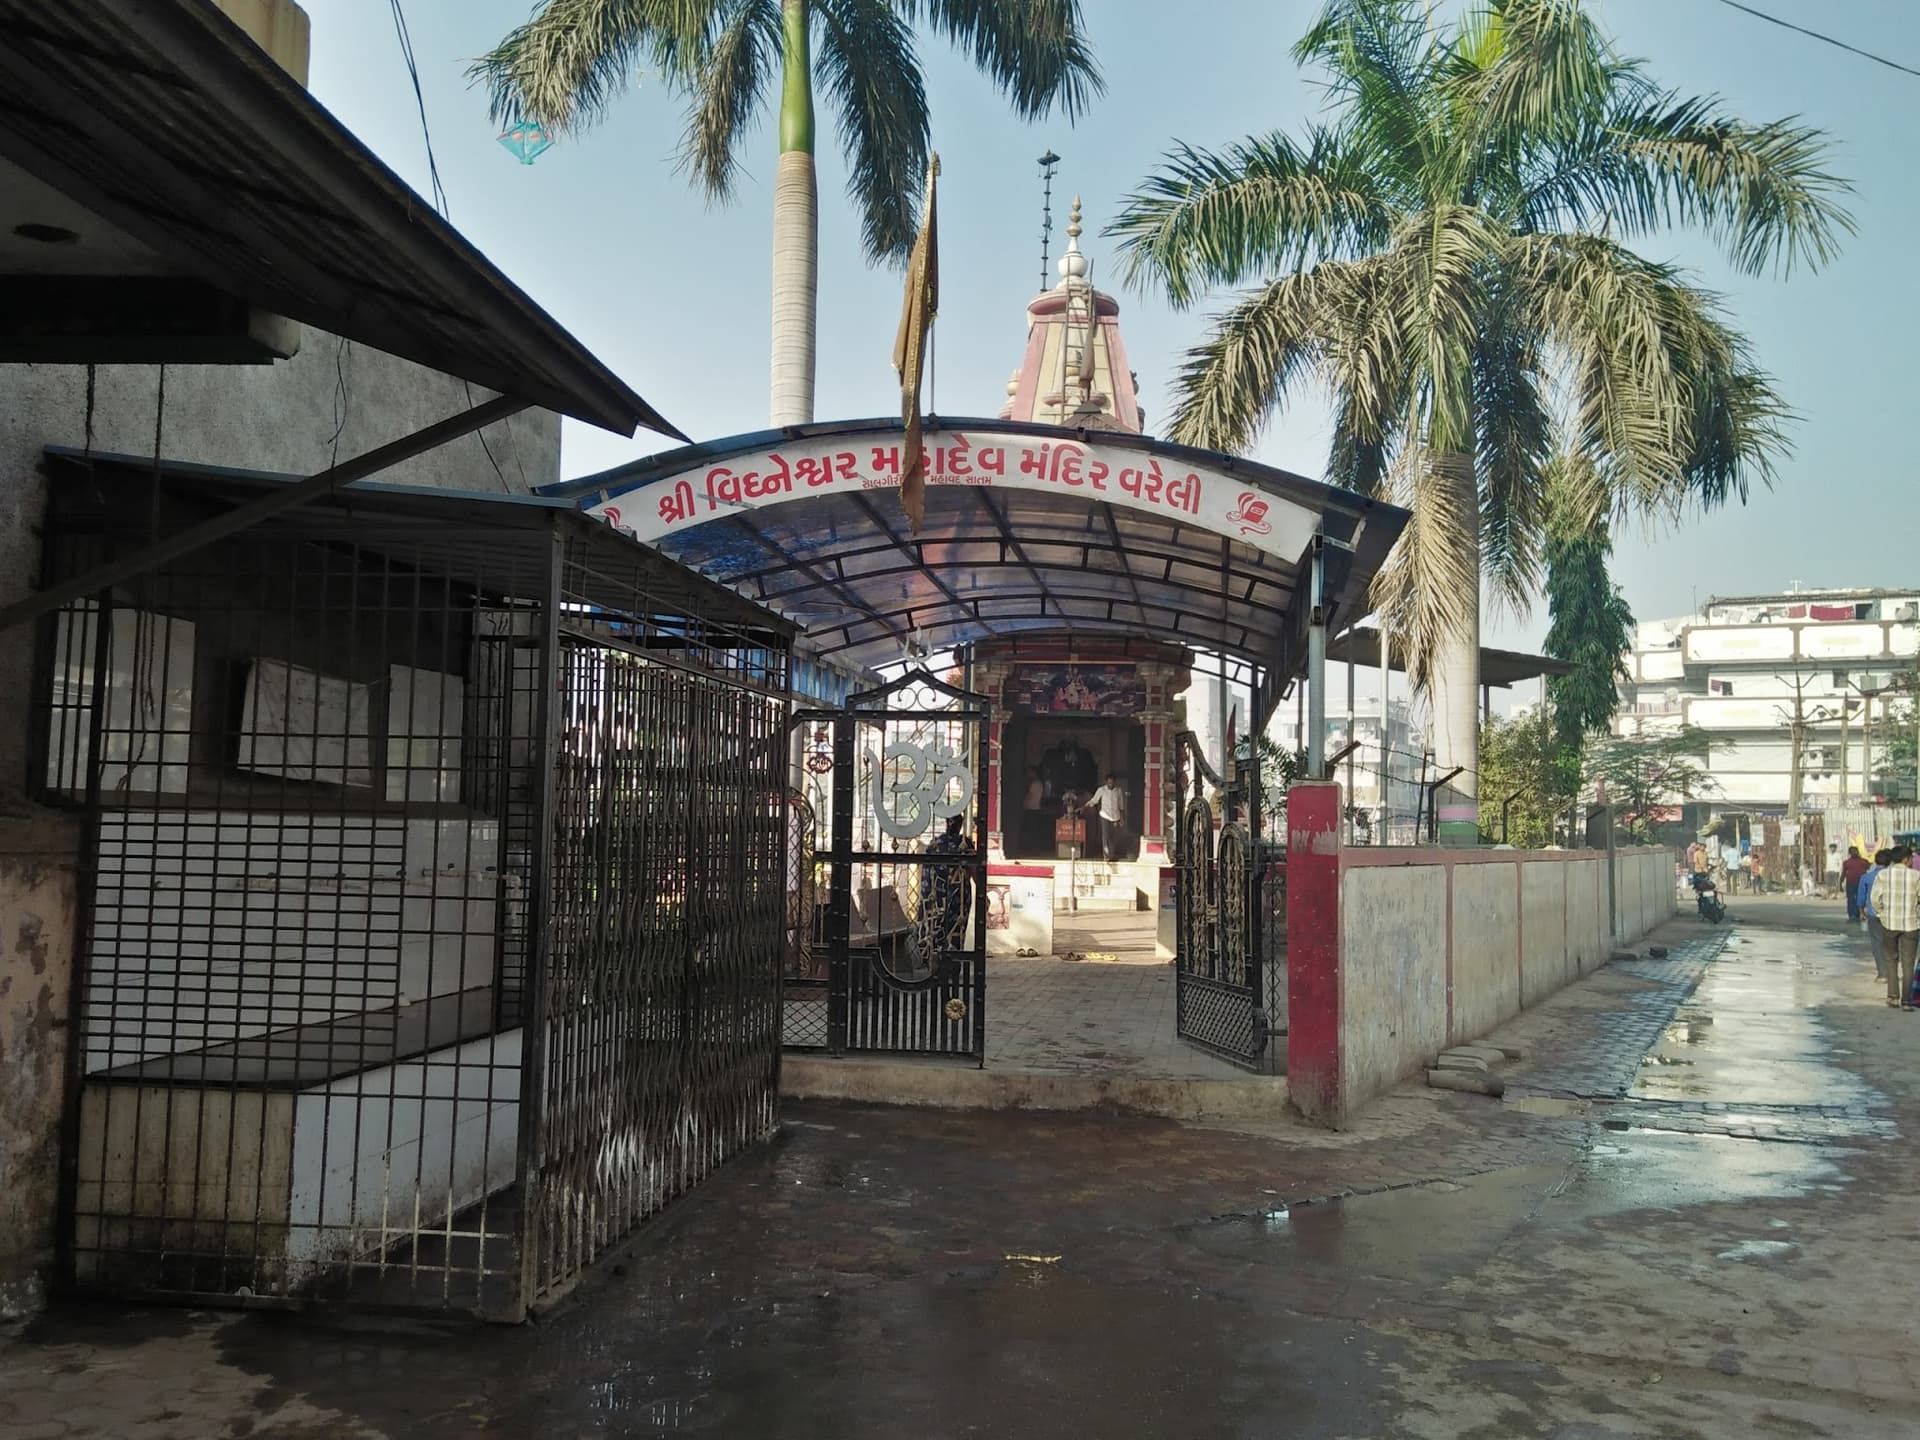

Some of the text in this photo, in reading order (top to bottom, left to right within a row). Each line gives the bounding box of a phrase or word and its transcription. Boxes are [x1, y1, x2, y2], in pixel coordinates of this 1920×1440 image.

[657, 480, 696, 525] શ્રી
[1019, 442, 1110, 491] મંદિર
[1118, 459, 1202, 515] વરેલી
